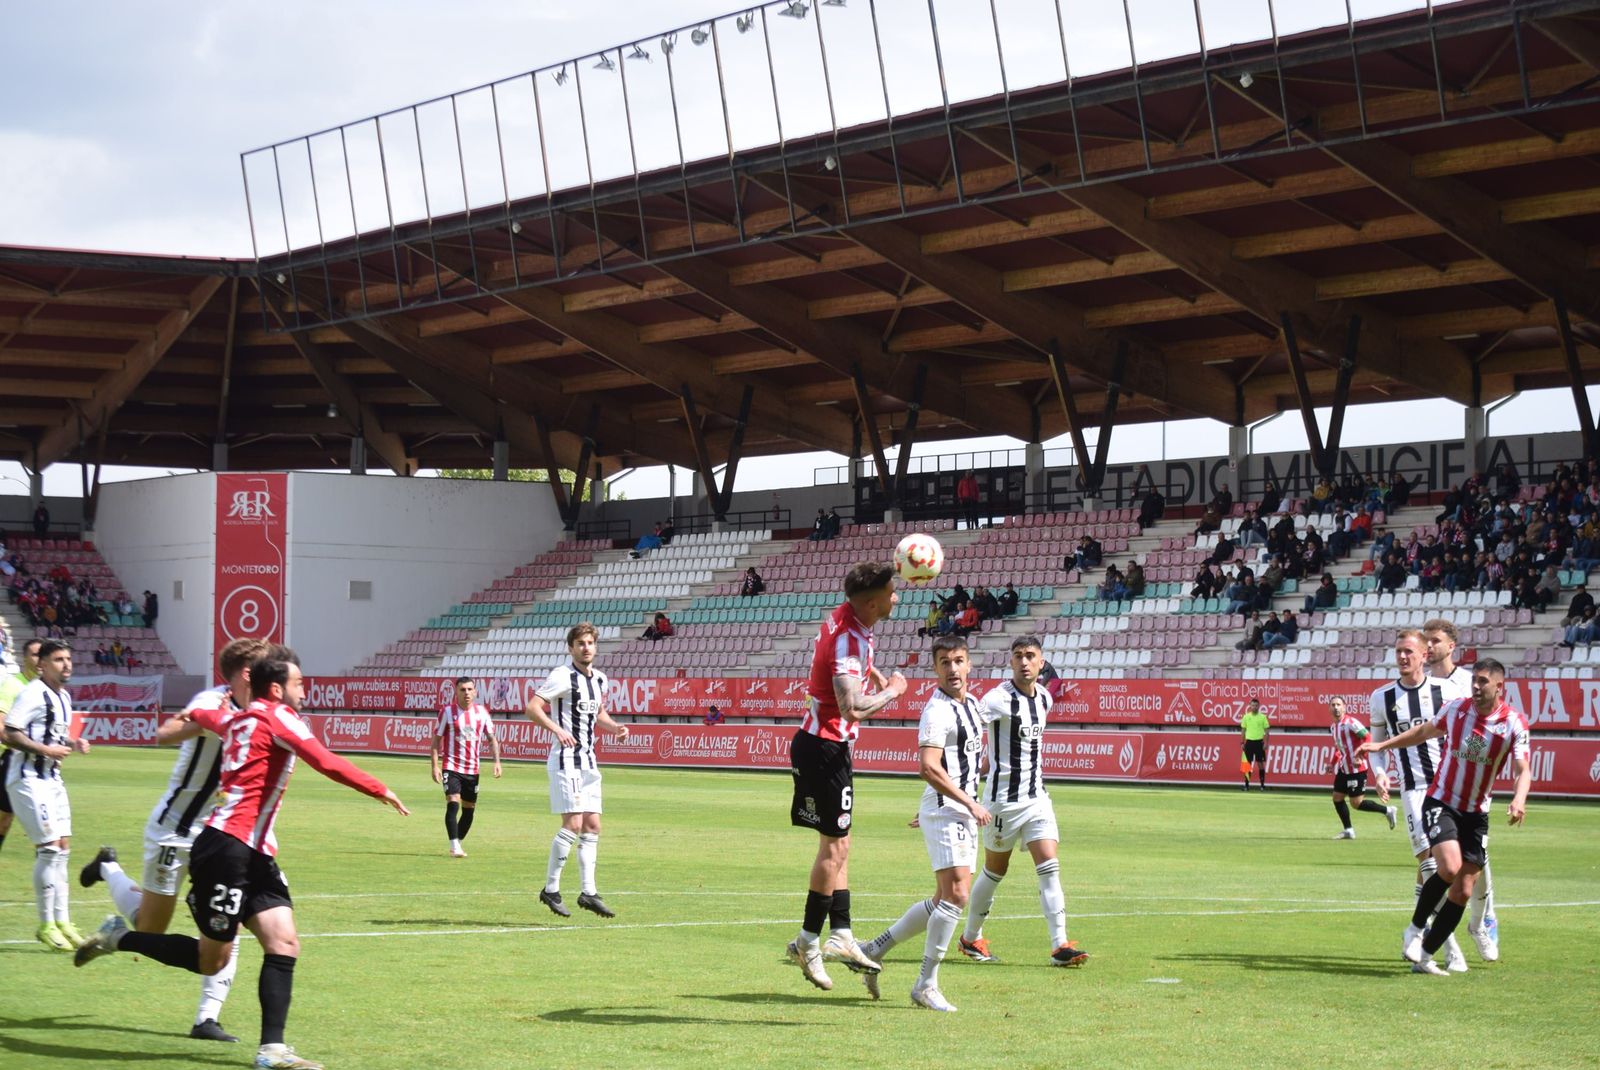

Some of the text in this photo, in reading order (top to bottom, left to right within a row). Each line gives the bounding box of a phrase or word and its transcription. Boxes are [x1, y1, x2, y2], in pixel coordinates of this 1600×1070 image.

[1047, 437, 1551, 511] ETADIO MNICIPAL
[221, 564, 280, 575] MONTETORO
[239, 599, 260, 633] 8
[346, 679, 438, 693] www.cubiex.es FUNDACIÓN
[1099, 684, 1128, 693] DESGUACES
[1201, 682, 1279, 698] Clínica Dental
[362, 696, 396, 707] 675 630 110
[664, 696, 696, 710] sangregorio
[740, 697, 775, 711] sangregorio
[1099, 694, 1162, 711] autorecicla
[1318, 692, 1370, 705] CANTERÍA
[1201, 698, 1278, 724] GonZez
[332, 717, 371, 739] Freigel
[393, 719, 432, 742] Freigel
[508, 724, 520, 742] DE
[520, 725, 530, 743] LA
[602, 734, 654, 747] VALDRADUEY
[674, 733, 739, 750] ELOY ÁLVAREZ
[502, 744, 516, 754] Vino
[518, 744, 549, 756] (Zamora)
[1041, 743, 1114, 756] IENDA ONLINE
[1168, 745, 1220, 762] VERSUS
[1172, 762, 1214, 772] E-LEARNING
[842, 786, 852, 810] 6
[798, 808, 821, 824] ZAMORA
[994, 815, 1003, 833] 4
[1425, 806, 1443, 826] 17
[158, 845, 177, 866] 16
[210, 884, 244, 916] 23
